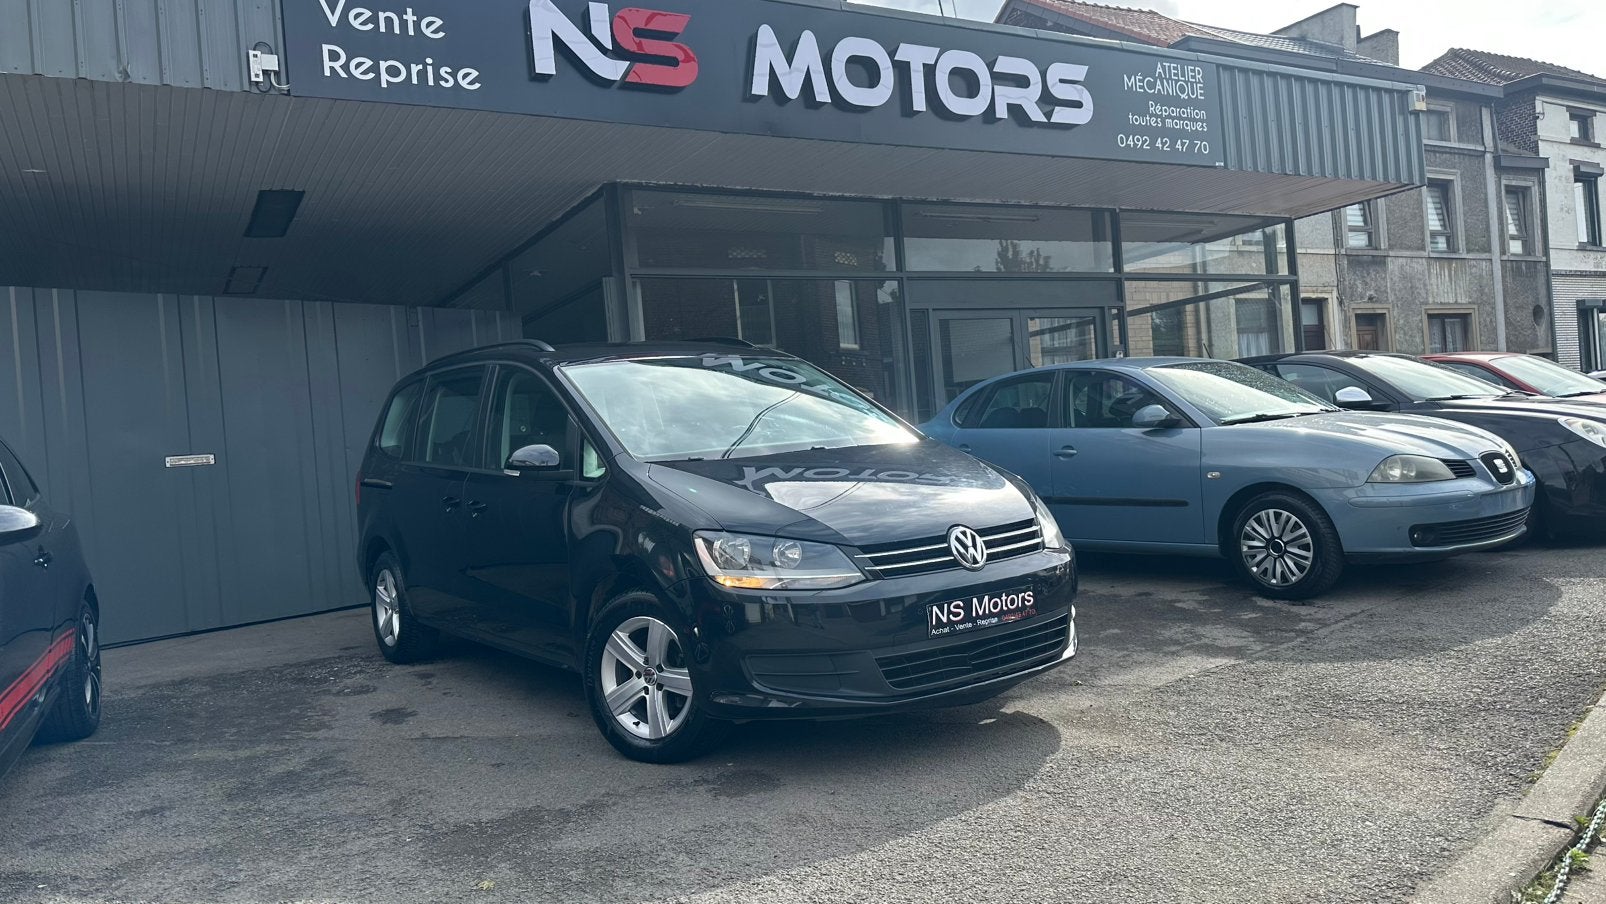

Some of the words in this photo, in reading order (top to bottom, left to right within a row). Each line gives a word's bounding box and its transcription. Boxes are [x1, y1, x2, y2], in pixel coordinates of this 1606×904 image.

[321, 0, 446, 39] Vente
[321, 43, 482, 91] Reprise
[528, 0, 699, 87] NS
[751, 23, 1095, 125] MOTORS
[1155, 61, 1204, 83] ATELIER
[1123, 73, 1205, 100] MÉCANIQUE
[1128, 112, 1162, 127] toutes
[1165, 119, 1208, 132] marques
[1148, 100, 1207, 120] Réparation
[1117, 133, 1151, 149] 0492
[1155, 137, 1171, 151] 42
[1175, 139, 1190, 153] 47
[1193, 140, 1210, 154] 70
[932, 600, 965, 626] NS
[972, 591, 1034, 618] Motors
[931, 627, 950, 636] Achat
[955, 622, 973, 631] Vente
[977, 616, 998, 627] Reprise
